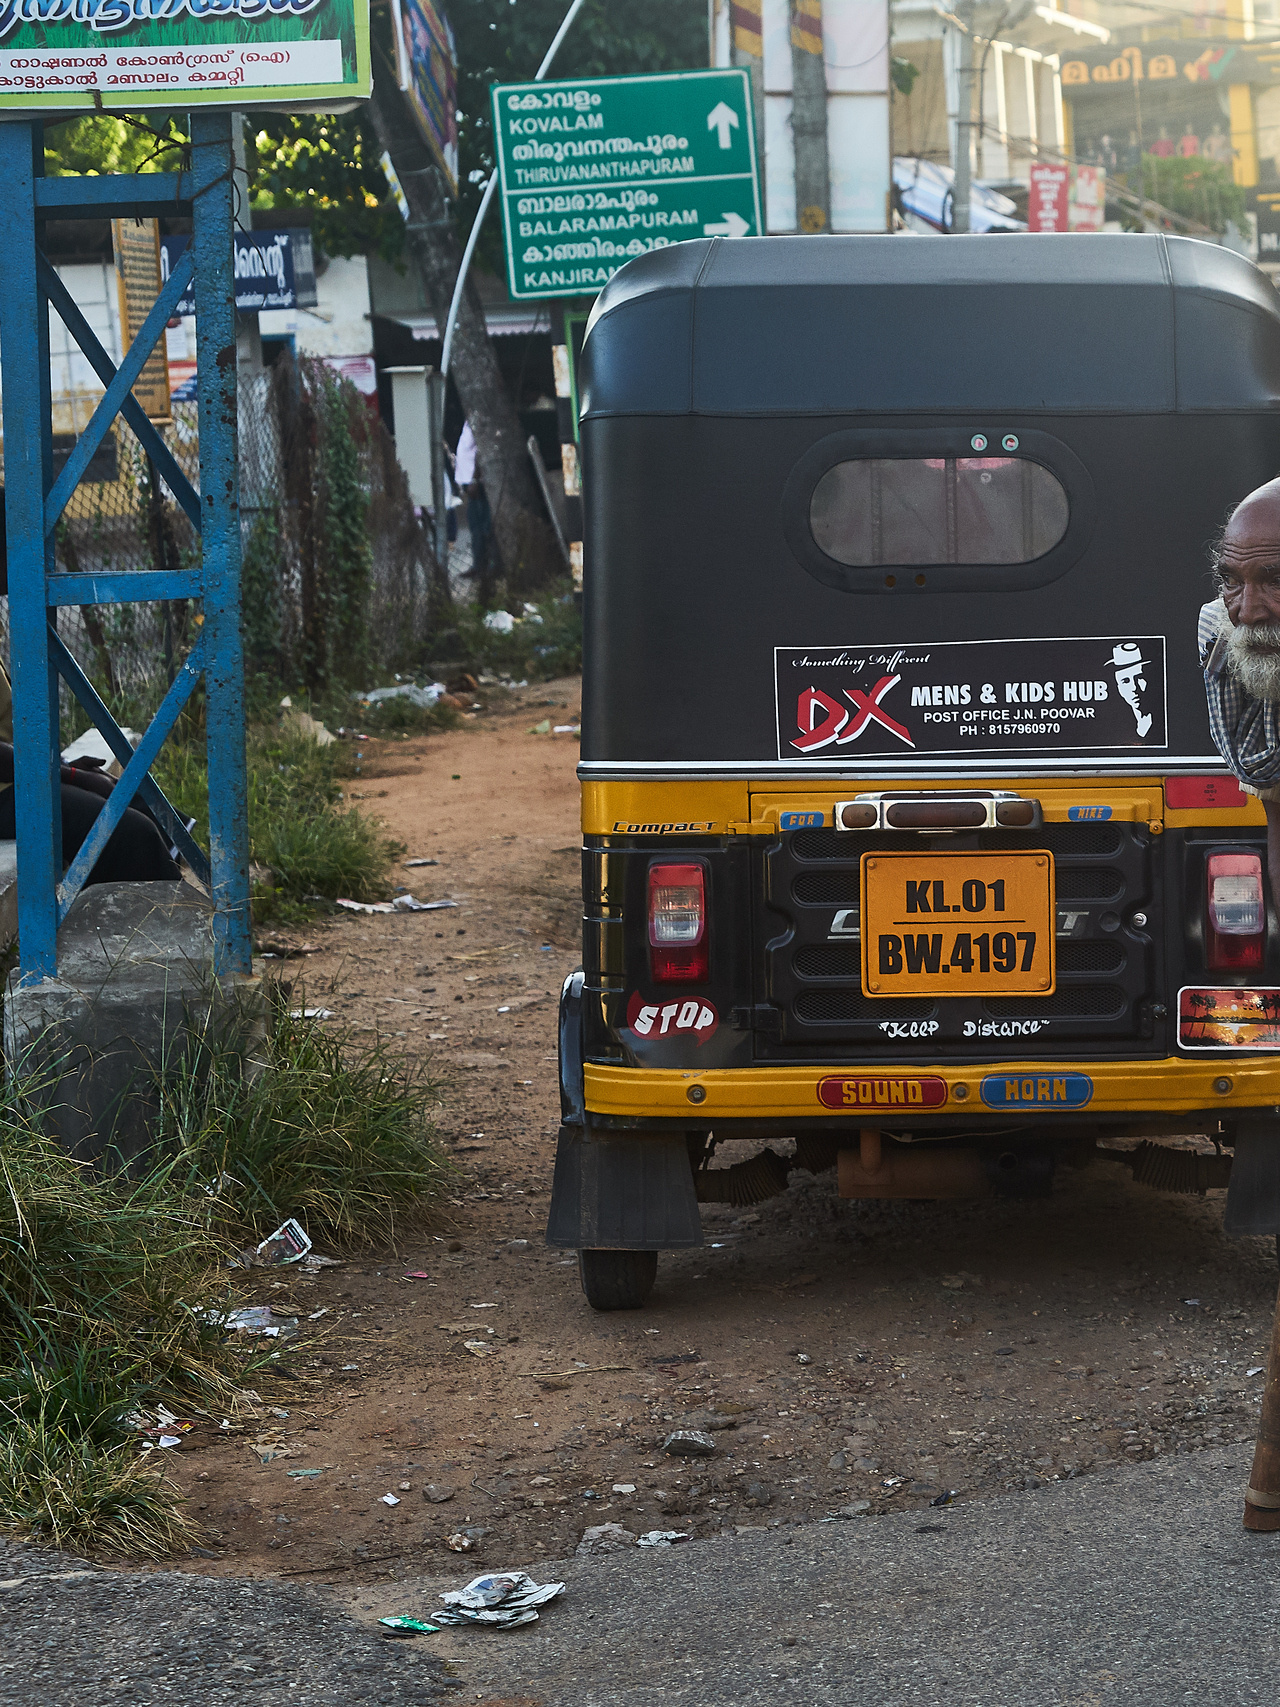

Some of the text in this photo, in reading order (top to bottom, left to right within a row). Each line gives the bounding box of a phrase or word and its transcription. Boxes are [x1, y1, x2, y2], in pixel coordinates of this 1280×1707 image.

[507, 90, 602, 112] കോവളം
[509, 113, 604, 135] KOVALAM
[512, 133, 689, 163] തിരുവനന്തപുരം
[515, 156, 695, 184] THIRUVANANTHAPURAM
[517, 190, 659, 212] ബാലരാമപുരം
[519, 209, 698, 237] BALARAMAPURAM
[792, 650, 930, 674] Something Different
[911, 680, 1109, 707] MENS & KIDS HUB
[789, 674, 916, 753] DX
[924, 707, 1096, 723] POST OFFICE J.N. POOVAR
[959, 725, 978, 736] PH
[988, 723, 1061, 735] 8157960970
[789, 814, 815, 826] FOR
[906, 879, 1005, 913] KL.01
[878, 932, 1037, 974] BW.4197
[634, 1002, 714, 1034] STOP
[843, 1078, 1067, 1104] SOUND HORN
